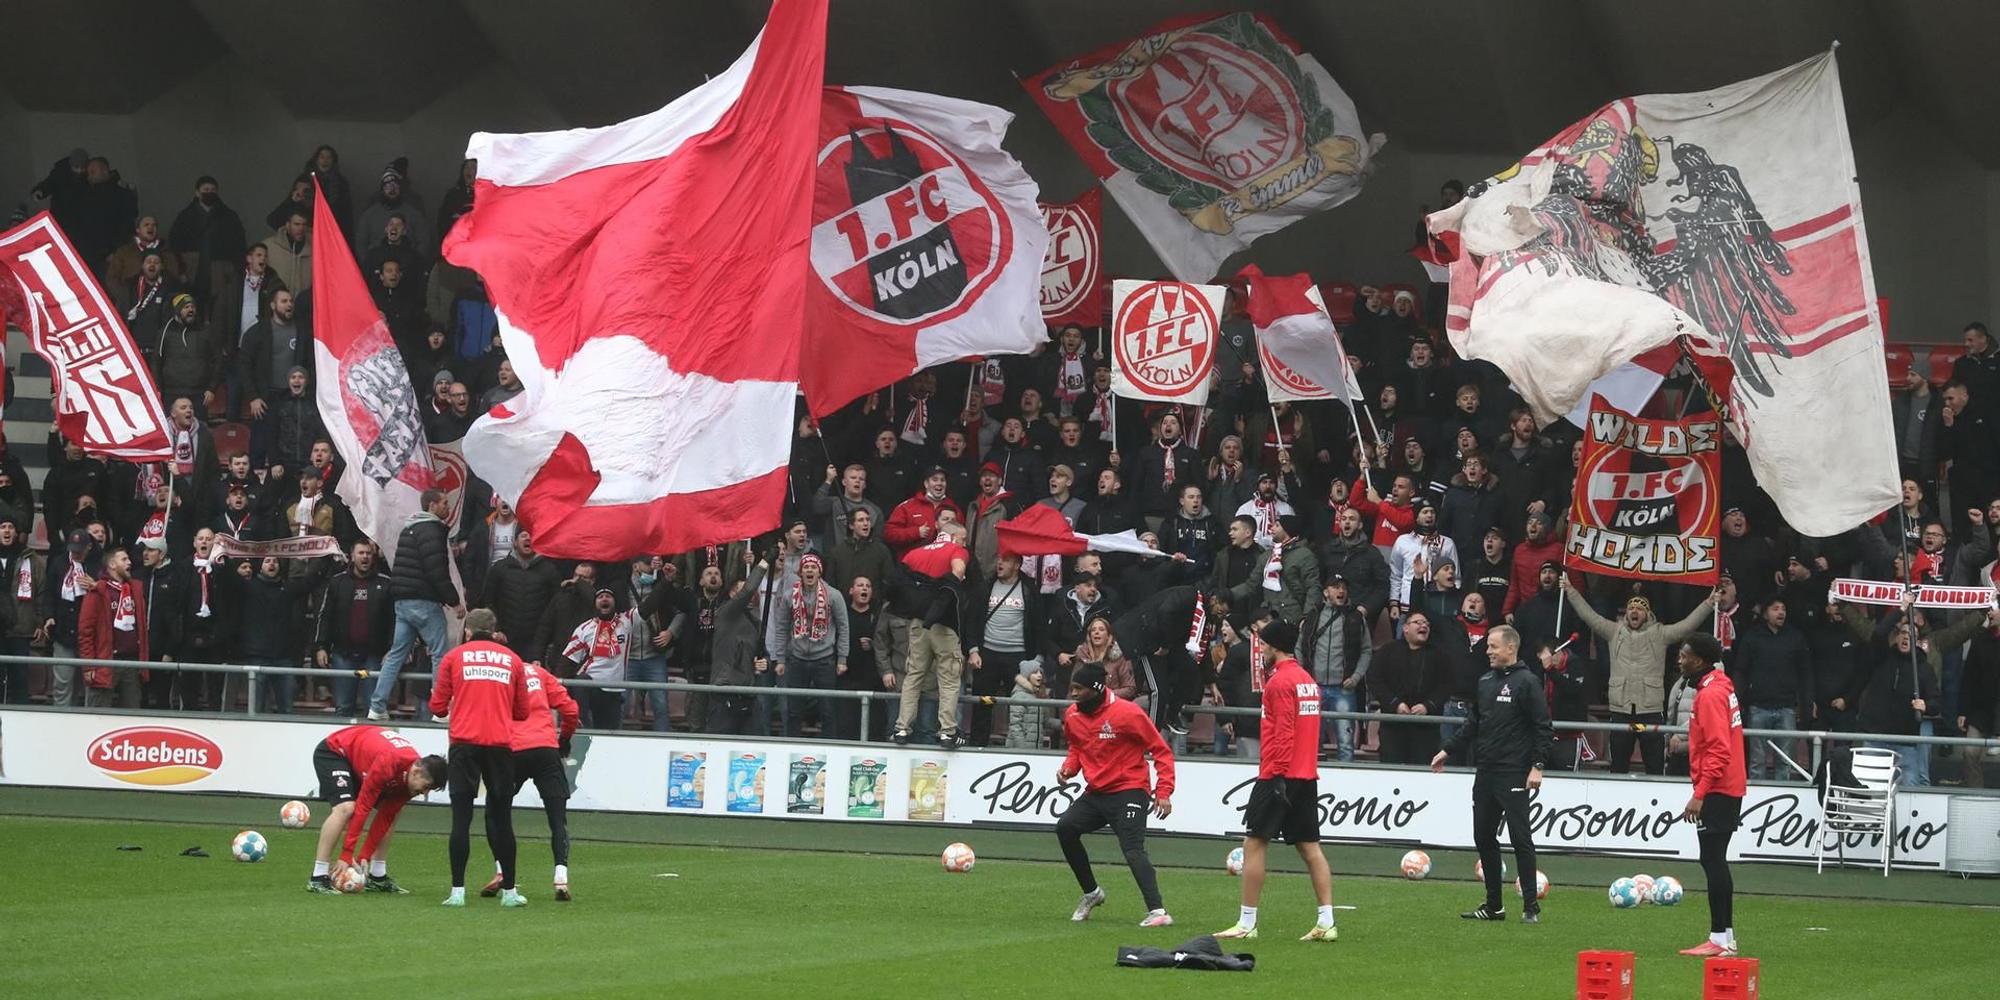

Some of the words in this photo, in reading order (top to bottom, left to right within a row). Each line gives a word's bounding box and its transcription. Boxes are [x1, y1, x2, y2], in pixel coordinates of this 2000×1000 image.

[835, 174, 949, 262] 1.FC
[873, 238, 959, 302] KÖLN
[1135, 315, 1196, 360] 1.FC
[1139, 362, 1192, 384] KÖLN
[1590, 412, 1718, 455] WILDE
[1612, 470, 1684, 499] 1.FC
[1615, 503, 1676, 528] KÖLN
[1567, 523, 1717, 574] HORDE
[1838, 583, 1901, 600] WILDE
[1919, 589, 1991, 604] HORDE
[462, 650, 512, 667] REWE
[464, 667, 509, 680] uhlsport
[100, 739, 208, 765] Schaebens
[970, 761, 1082, 819] Pers
[1497, 787, 1687, 842] ersonio
